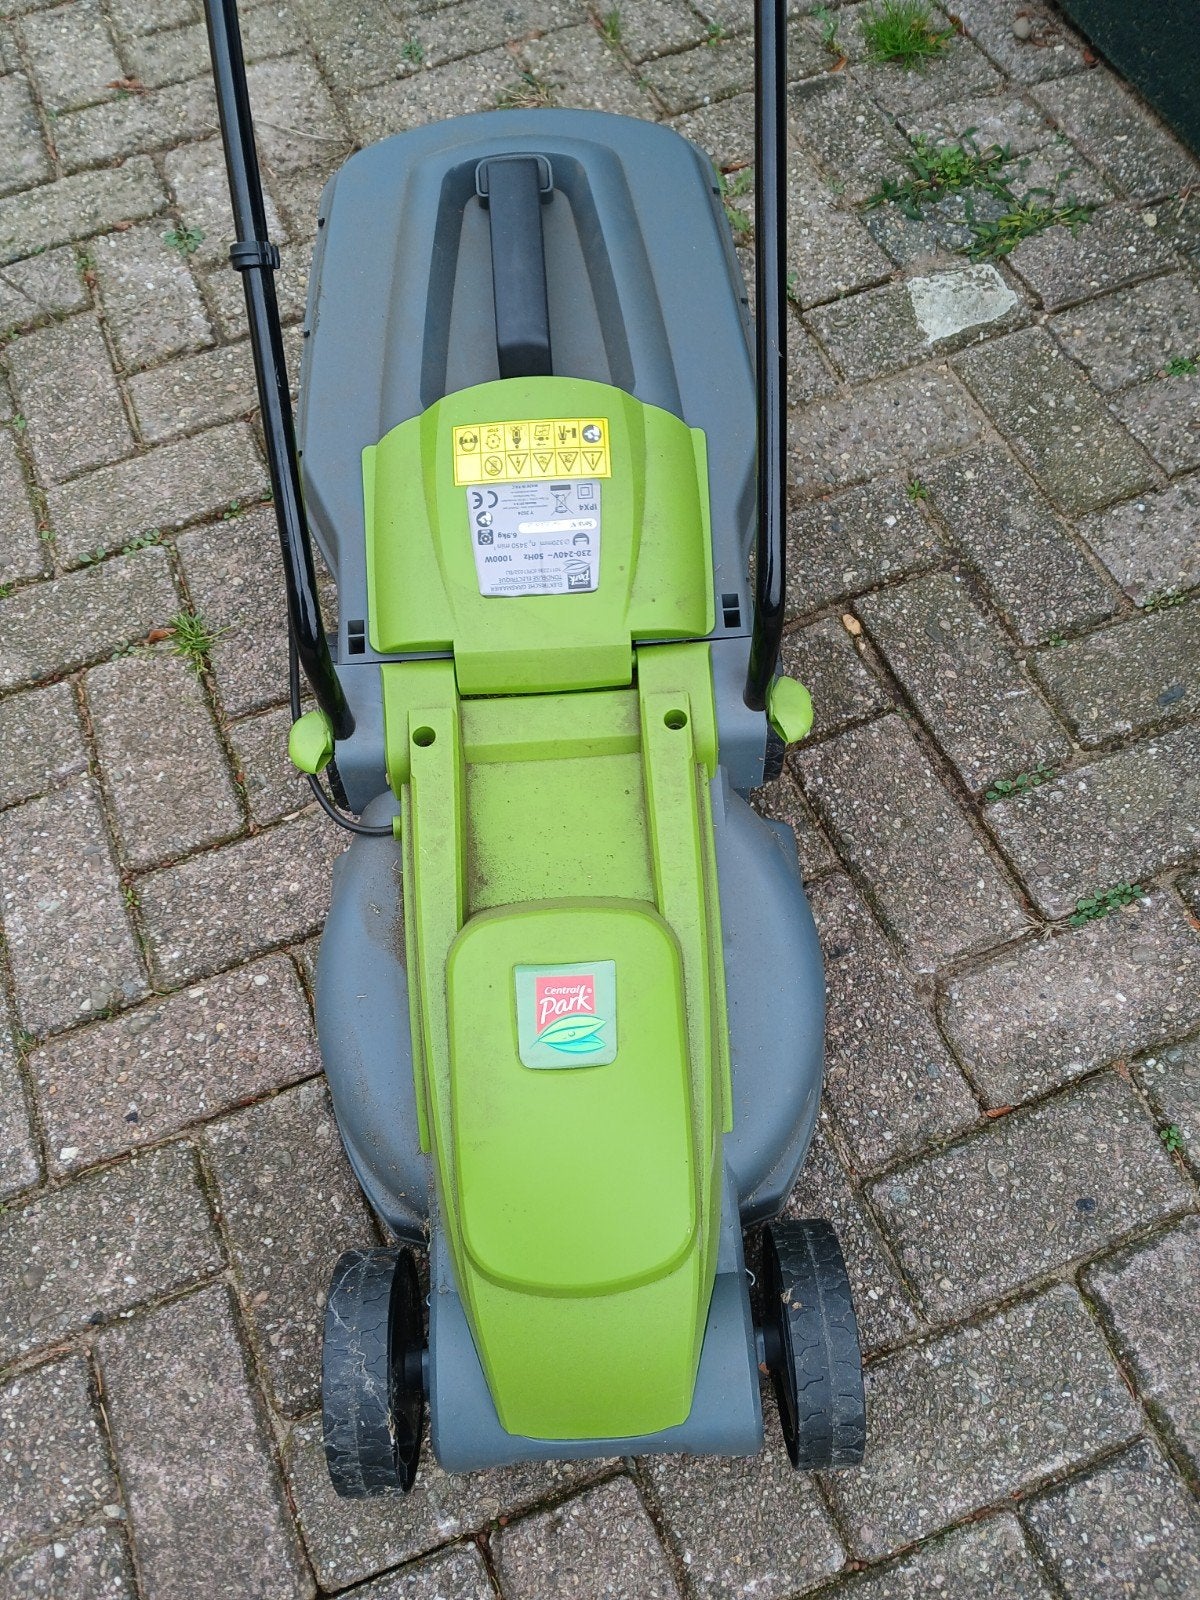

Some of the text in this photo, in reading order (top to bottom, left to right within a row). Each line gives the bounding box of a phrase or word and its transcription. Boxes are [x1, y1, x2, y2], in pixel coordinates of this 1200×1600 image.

[485, 555, 512, 563] 1000W
[568, 570, 590, 585] Park
[544, 985, 580, 995] Central
[540, 985, 592, 1024] Park
